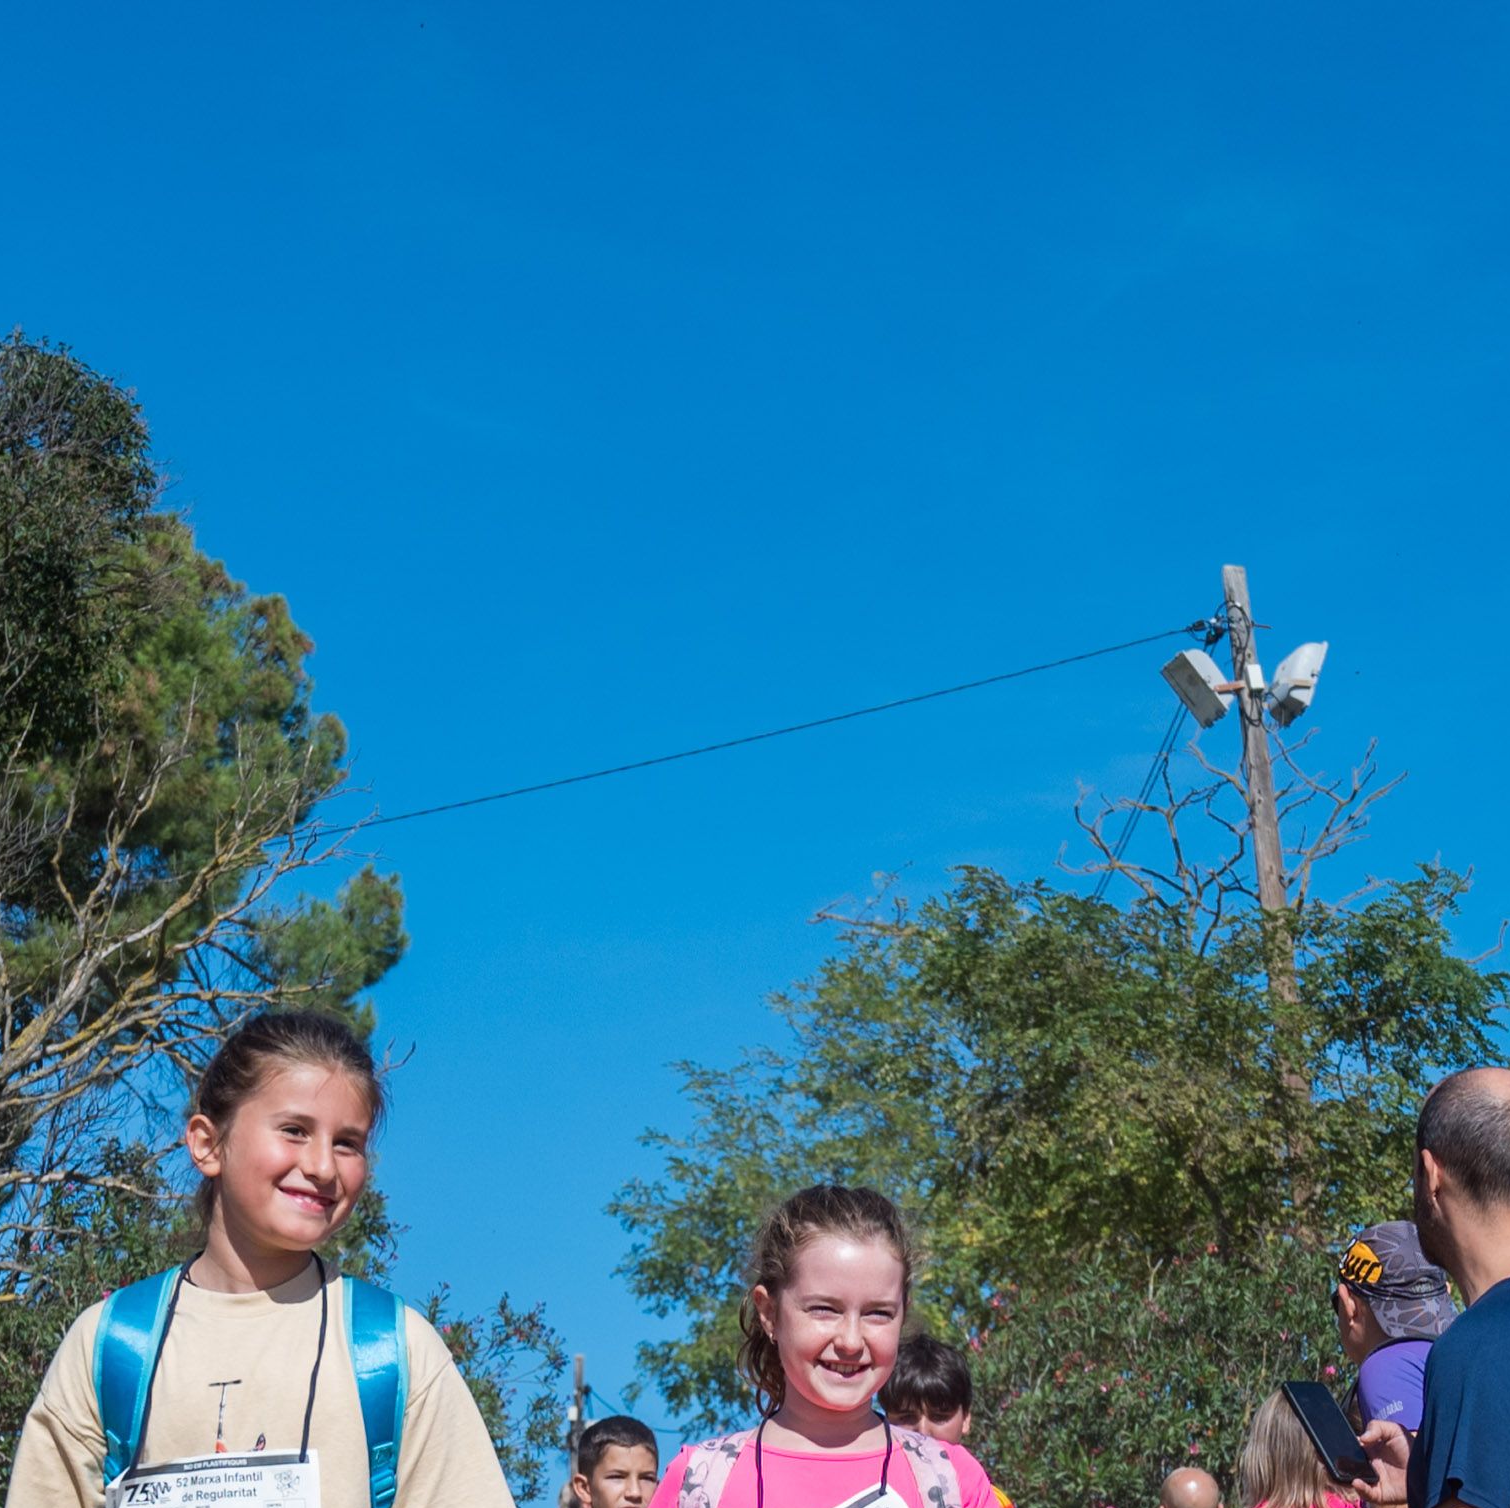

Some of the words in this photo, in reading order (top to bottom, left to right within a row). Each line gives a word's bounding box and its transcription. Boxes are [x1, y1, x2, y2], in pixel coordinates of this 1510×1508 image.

[176, 1477, 189, 1488] 52
[190, 1475, 221, 1486] Marxa
[224, 1471, 263, 1484] Infantil
[181, 1492, 194, 1502] de
[195, 1487, 258, 1502] Regularitat
